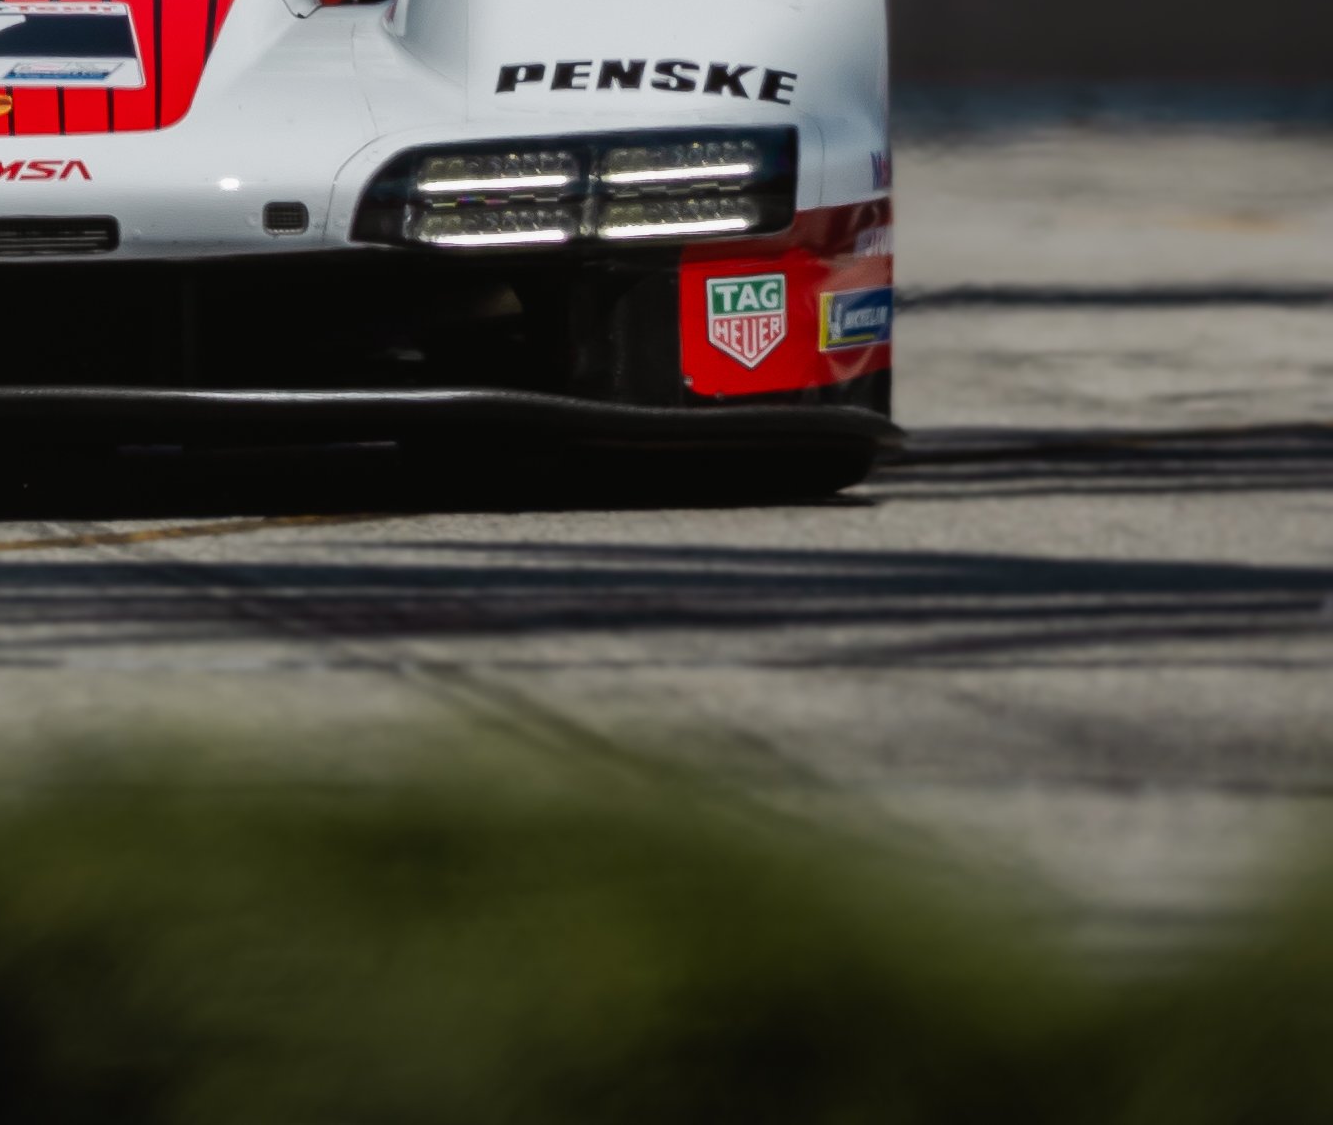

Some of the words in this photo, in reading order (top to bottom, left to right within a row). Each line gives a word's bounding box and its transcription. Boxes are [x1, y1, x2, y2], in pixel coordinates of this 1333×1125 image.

[495, 58, 798, 105] PENSKE
[715, 282, 778, 312] TAG
[714, 317, 781, 359] HEUER
